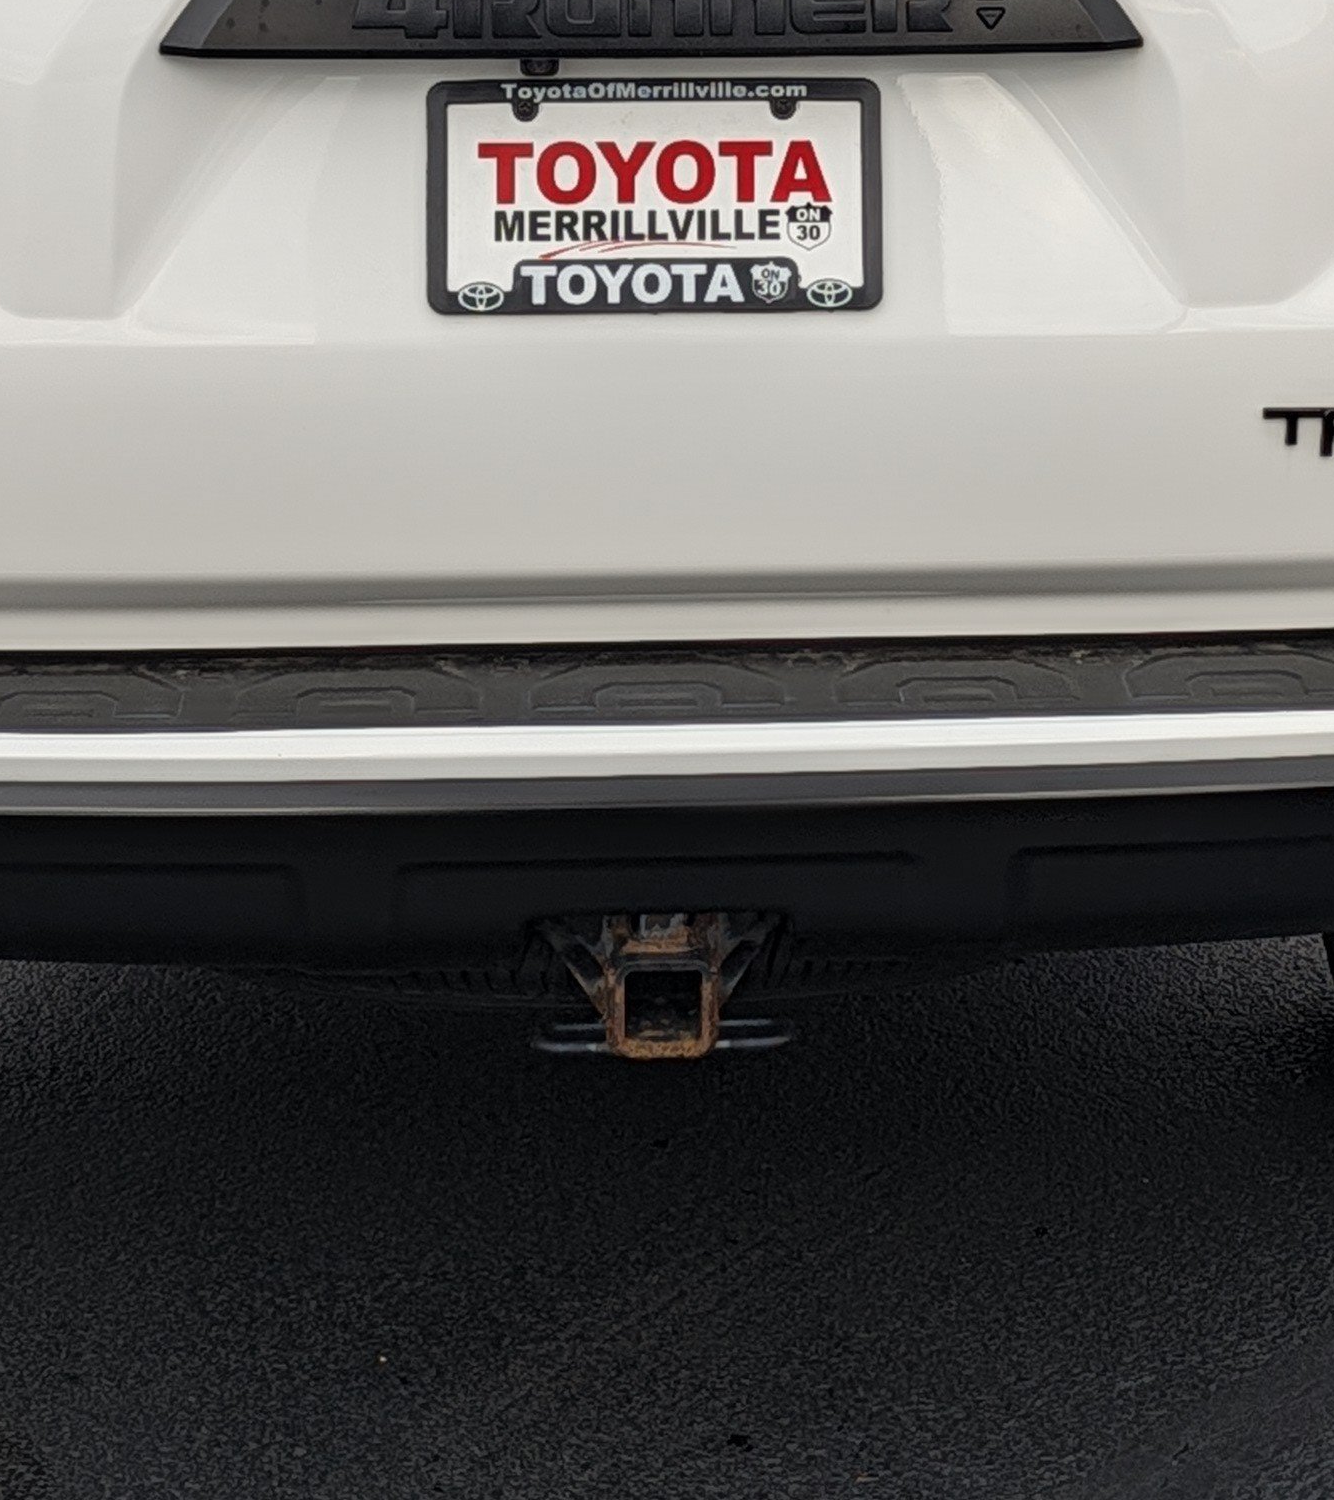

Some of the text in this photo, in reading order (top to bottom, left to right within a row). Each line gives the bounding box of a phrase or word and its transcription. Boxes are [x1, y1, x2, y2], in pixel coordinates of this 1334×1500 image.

[500, 82, 809, 101] ToyotaOfMerrillville.com
[478, 140, 832, 203] TOYOTA
[796, 208, 821, 222] ON
[494, 209, 780, 241] MERRILLVILLE
[796, 225, 821, 241] 30
[761, 268, 780, 280] ON
[521, 265, 745, 304] TOYOTA
[757, 280, 782, 296] 30
